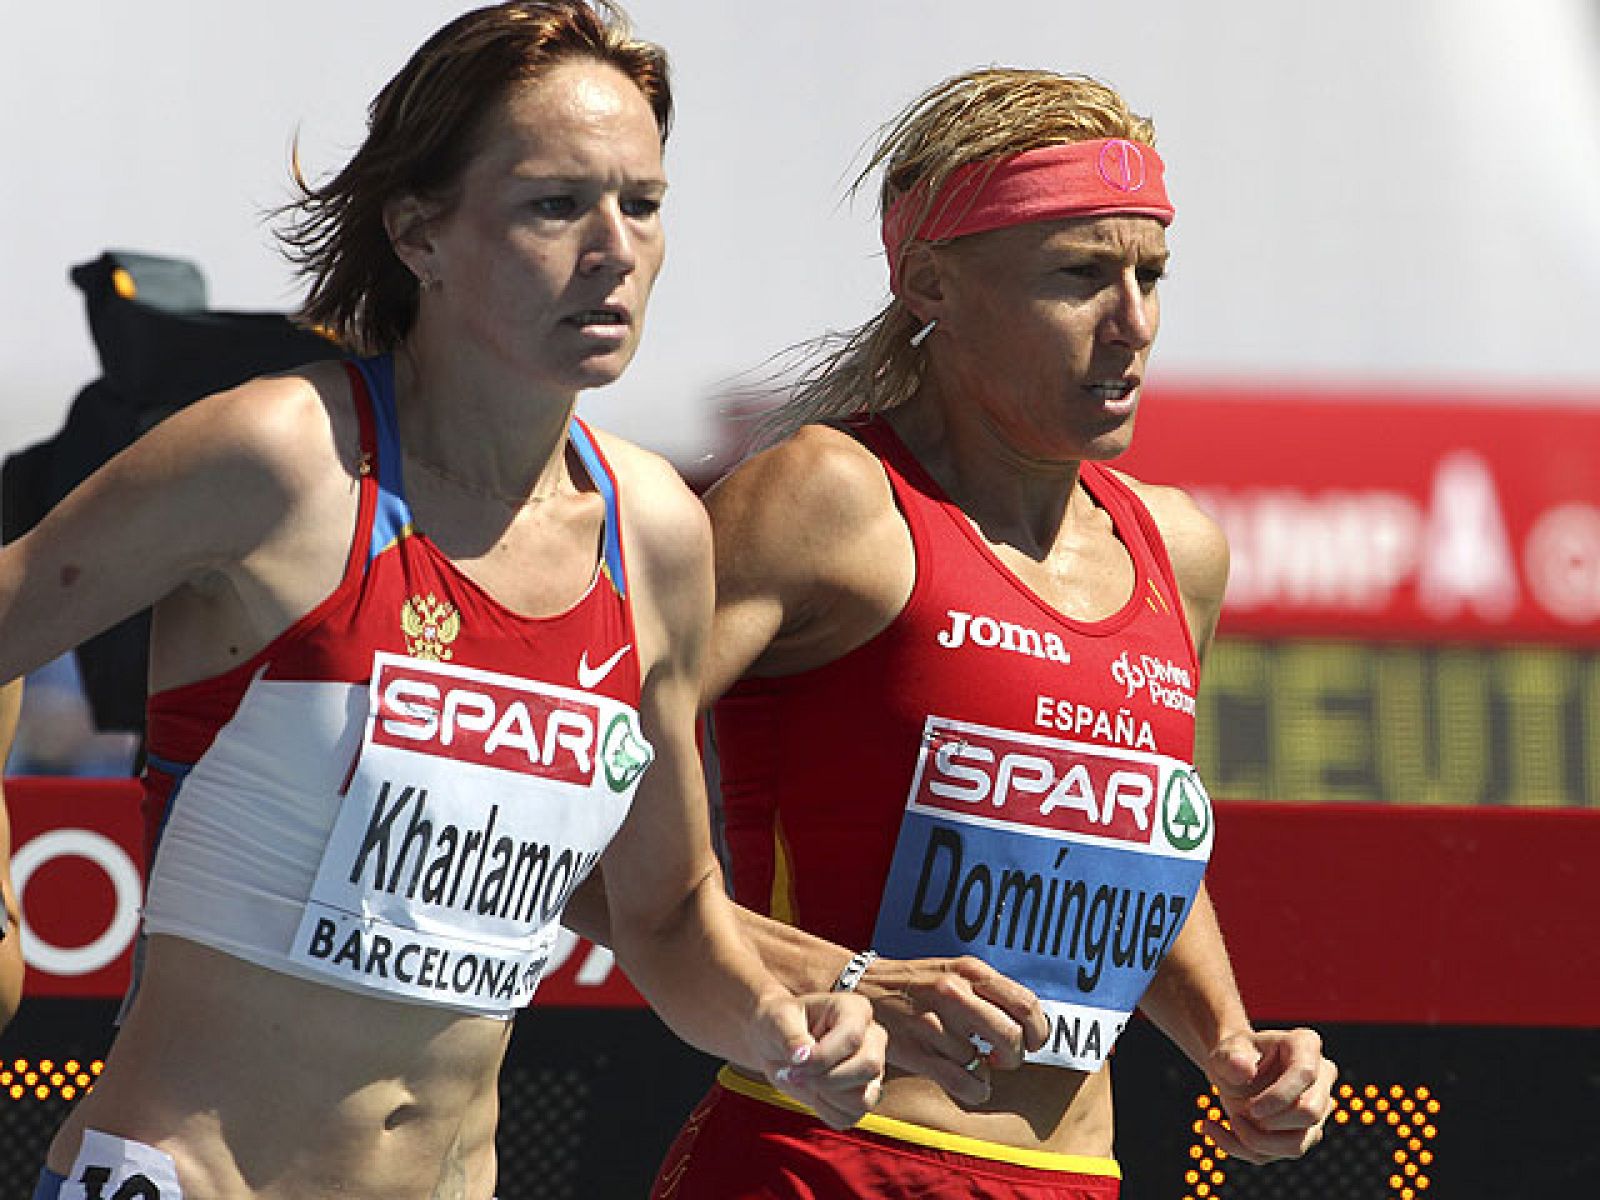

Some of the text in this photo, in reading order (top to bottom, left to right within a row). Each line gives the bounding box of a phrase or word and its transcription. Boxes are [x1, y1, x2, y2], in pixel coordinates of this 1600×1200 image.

[937, 609, 1071, 665] Joma
[382, 679, 596, 773] SPAR
[1035, 694, 1157, 751] ESPAÑA
[929, 743, 1155, 831] SPAR
[908, 827, 1186, 993] Domínguez
